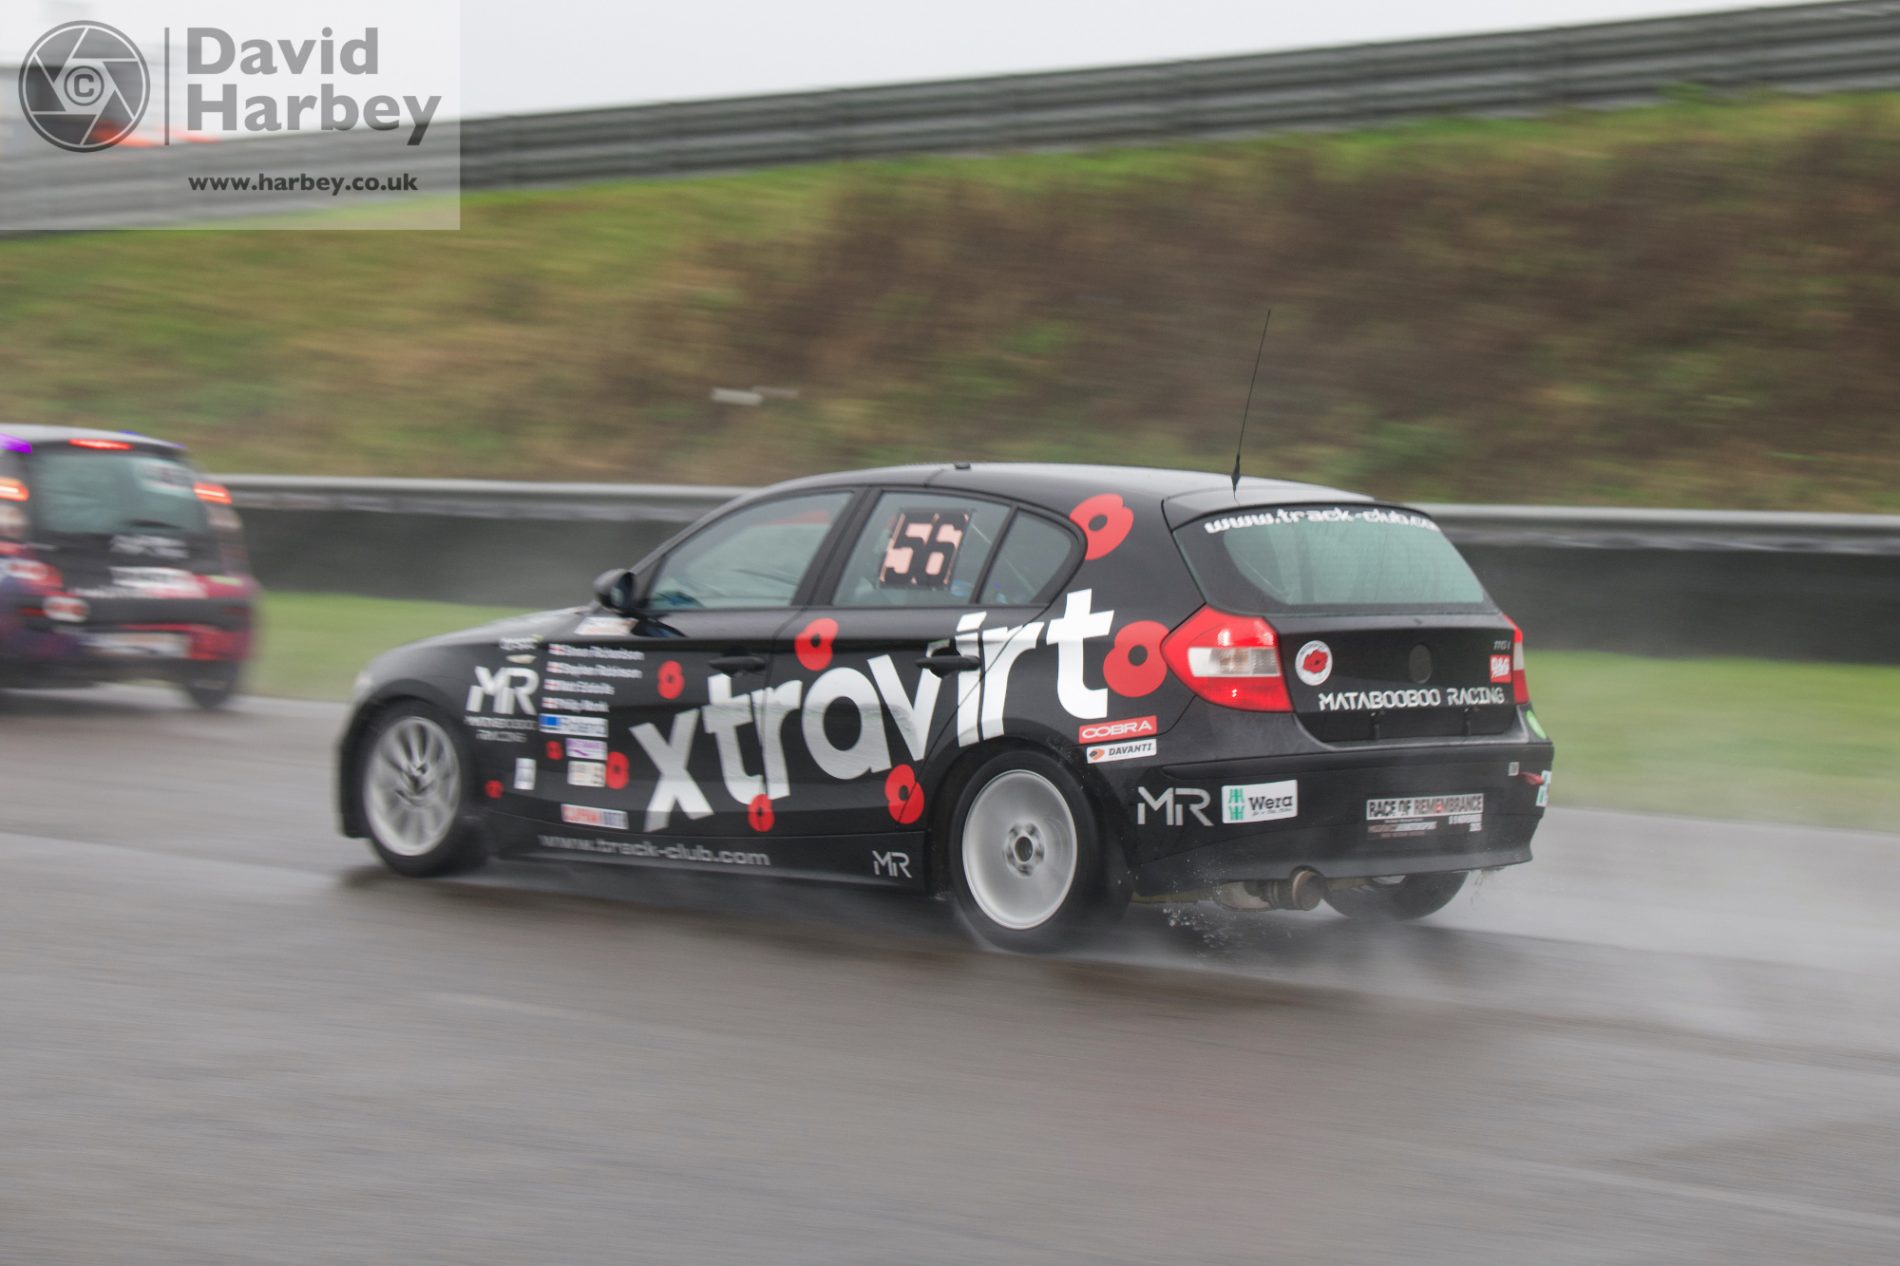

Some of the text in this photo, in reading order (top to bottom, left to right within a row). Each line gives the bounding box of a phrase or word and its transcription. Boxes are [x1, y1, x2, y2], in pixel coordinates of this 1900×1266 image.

[465, 665, 539, 716] MR
[1318, 686, 1505, 711] MATABOOBOO RACING
[629, 588, 1115, 834] xtravirt
[1082, 720, 1152, 739] COBRA
[1108, 743, 1152, 756] DAVANTI
[1137, 786, 1214, 827] MR
[1248, 796, 1293, 811] Wera
[1369, 800, 1396, 817] RACE
[538, 834, 770, 866] www.track-club.com
[872, 850, 912, 878] MR
